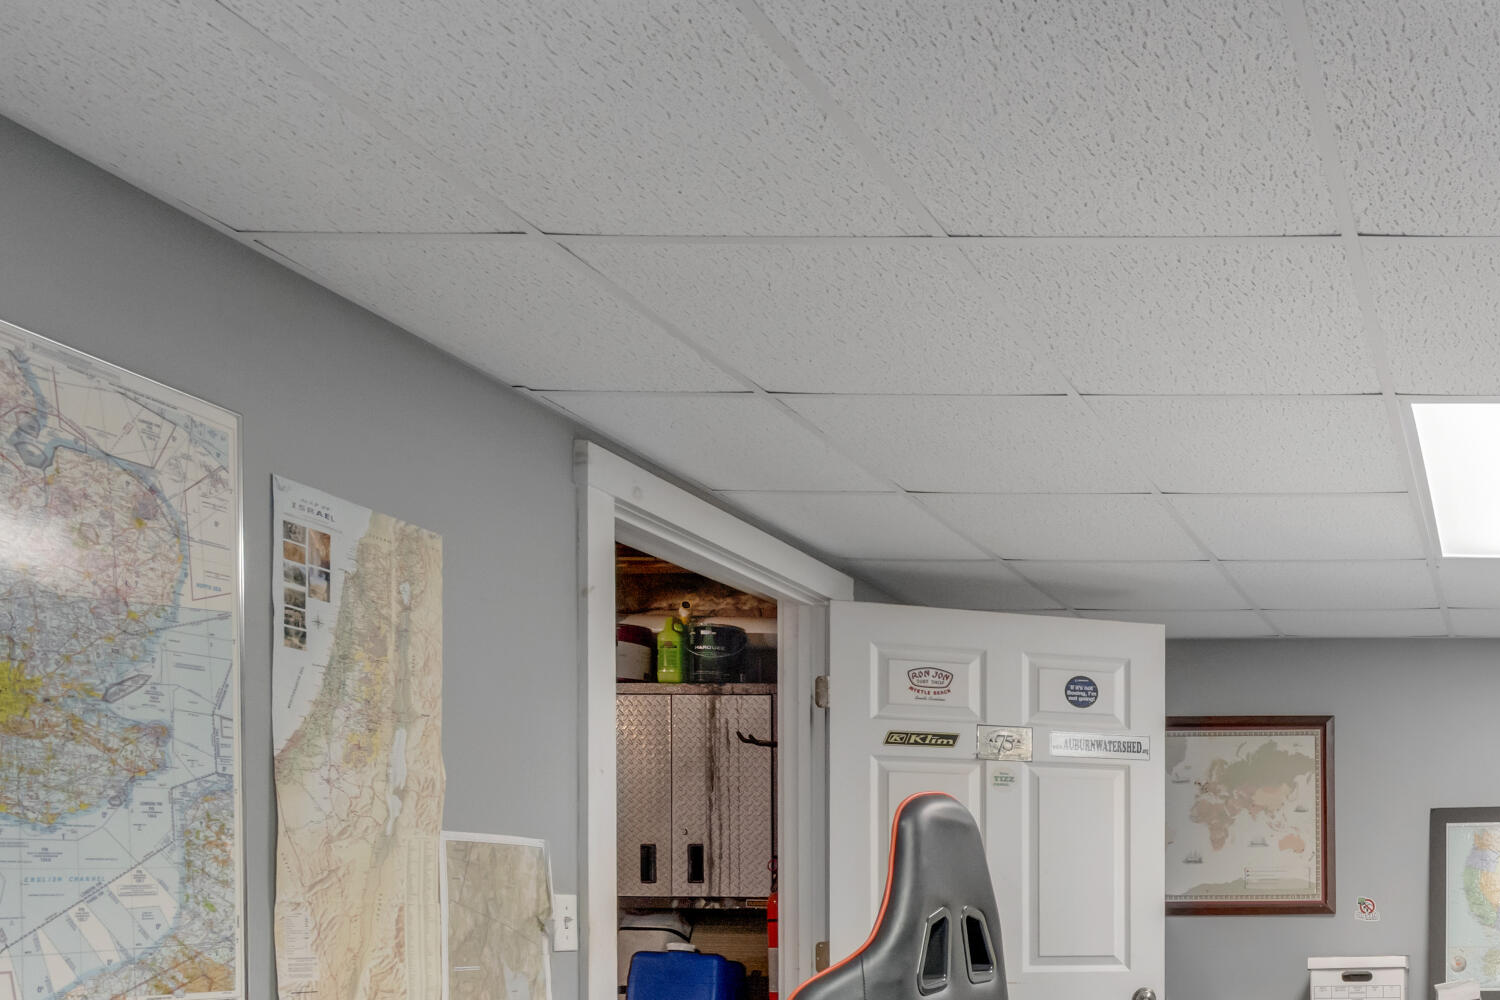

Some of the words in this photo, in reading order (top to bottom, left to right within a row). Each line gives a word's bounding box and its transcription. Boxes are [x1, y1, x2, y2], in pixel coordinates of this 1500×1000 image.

[291, 502, 336, 523] ISRAEL
[912, 669, 930, 680] RON
[932, 671, 950, 681] JON
[909, 734, 955, 745] Klim
